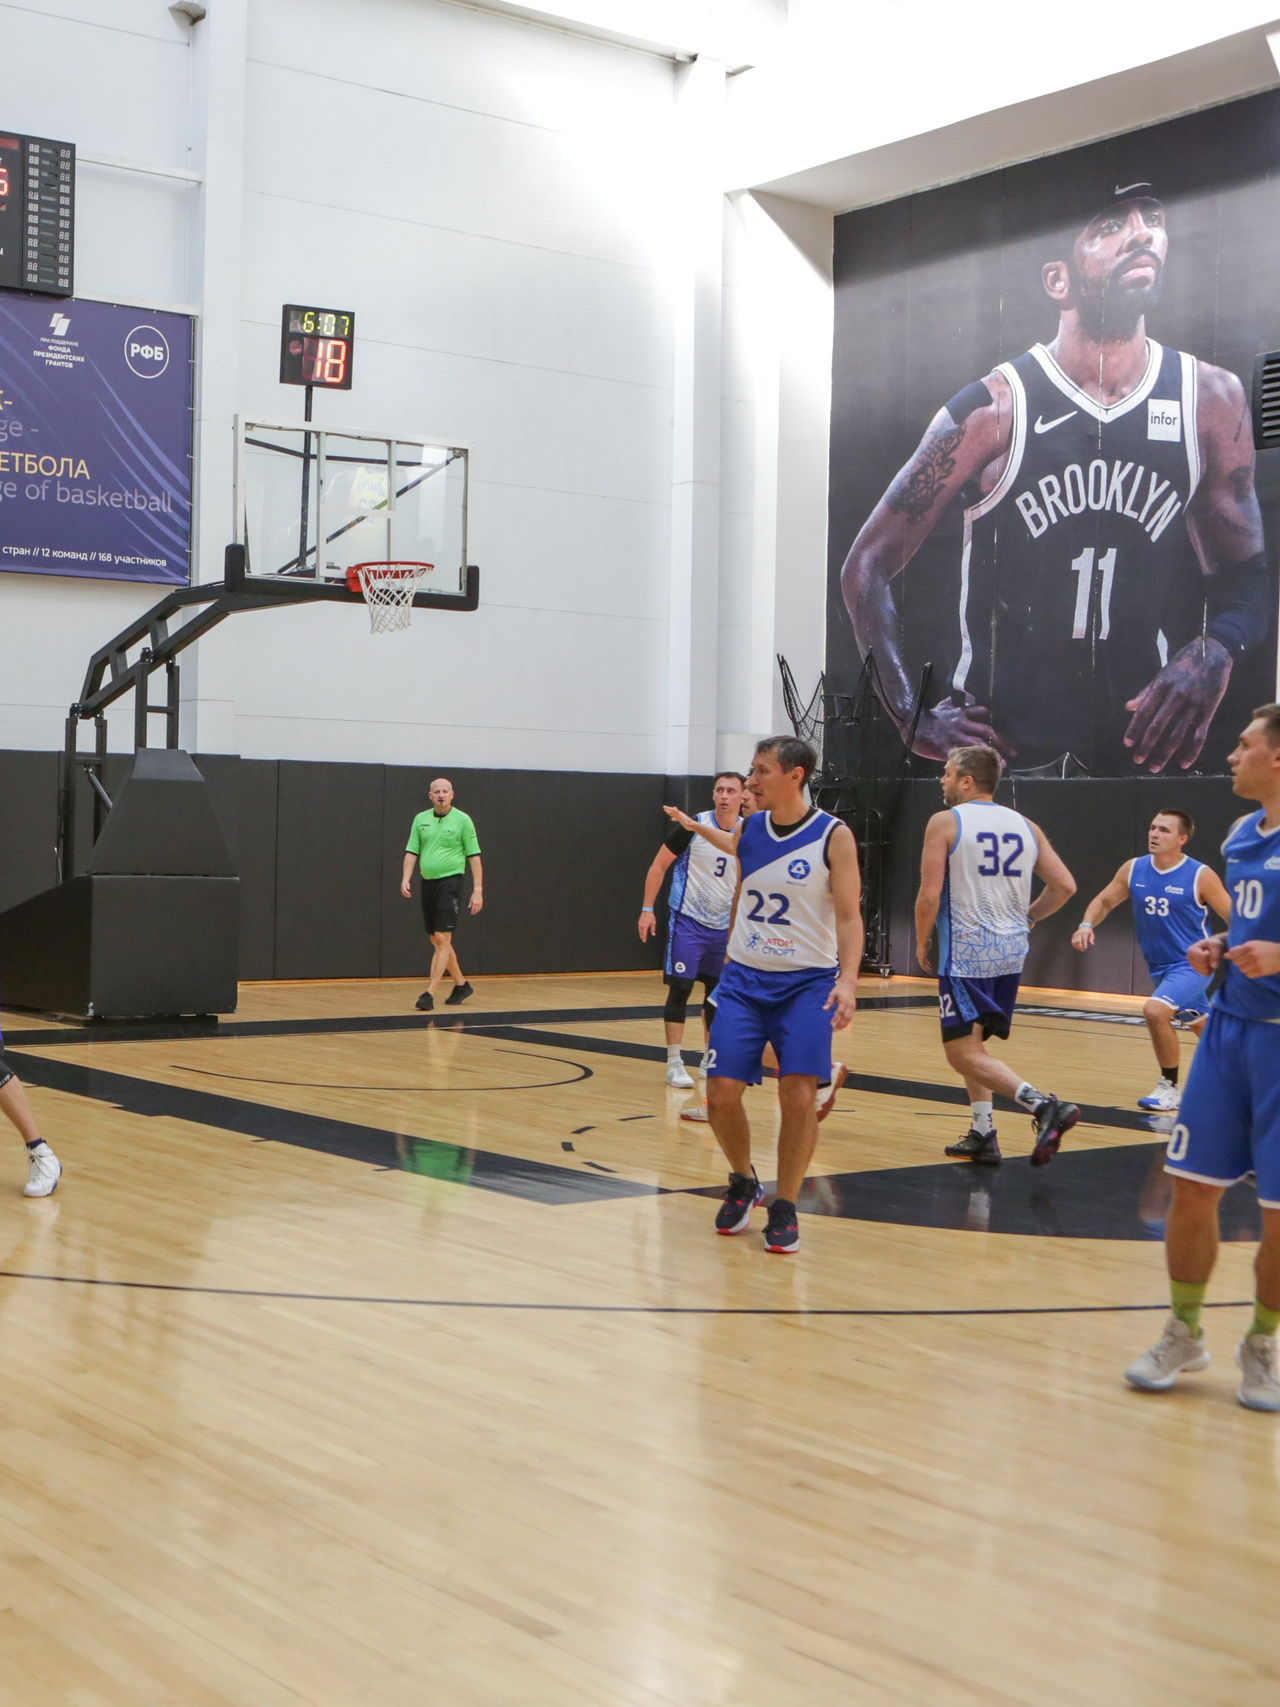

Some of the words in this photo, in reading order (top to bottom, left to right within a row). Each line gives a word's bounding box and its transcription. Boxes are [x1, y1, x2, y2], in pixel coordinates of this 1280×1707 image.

[302, 311, 350, 336] 6:07
[33, 350, 85, 363] ПРЕЗИДЕНТСКИХ
[48, 345, 71, 353] ФОНДА
[131, 343, 164, 361] РФБ
[45, 359, 73, 368] ГРАНТОВ
[315, 340, 347, 383] 18
[1150, 411, 1178, 427] infor
[25, 479, 51, 500] of
[56, 480, 173, 513] basketball
[1015, 458, 1182, 543] BROOKLYN
[2, 546, 31, 557] стран
[41, 548, 50, 557] 12
[52, 550, 88, 561] команд
[98, 552, 112, 562] 168
[114, 554, 167, 567] участников
[1071, 547, 1117, 640] 11
[976, 832, 1024, 877] 32
[714, 857, 727, 878] 3
[747, 889, 791, 926] 22
[1144, 895, 1169, 917] 33
[1233, 879, 1264, 919] 10
[762, 946, 796, 957] СПОРТ
[766, 938, 794, 948] АТОМ
